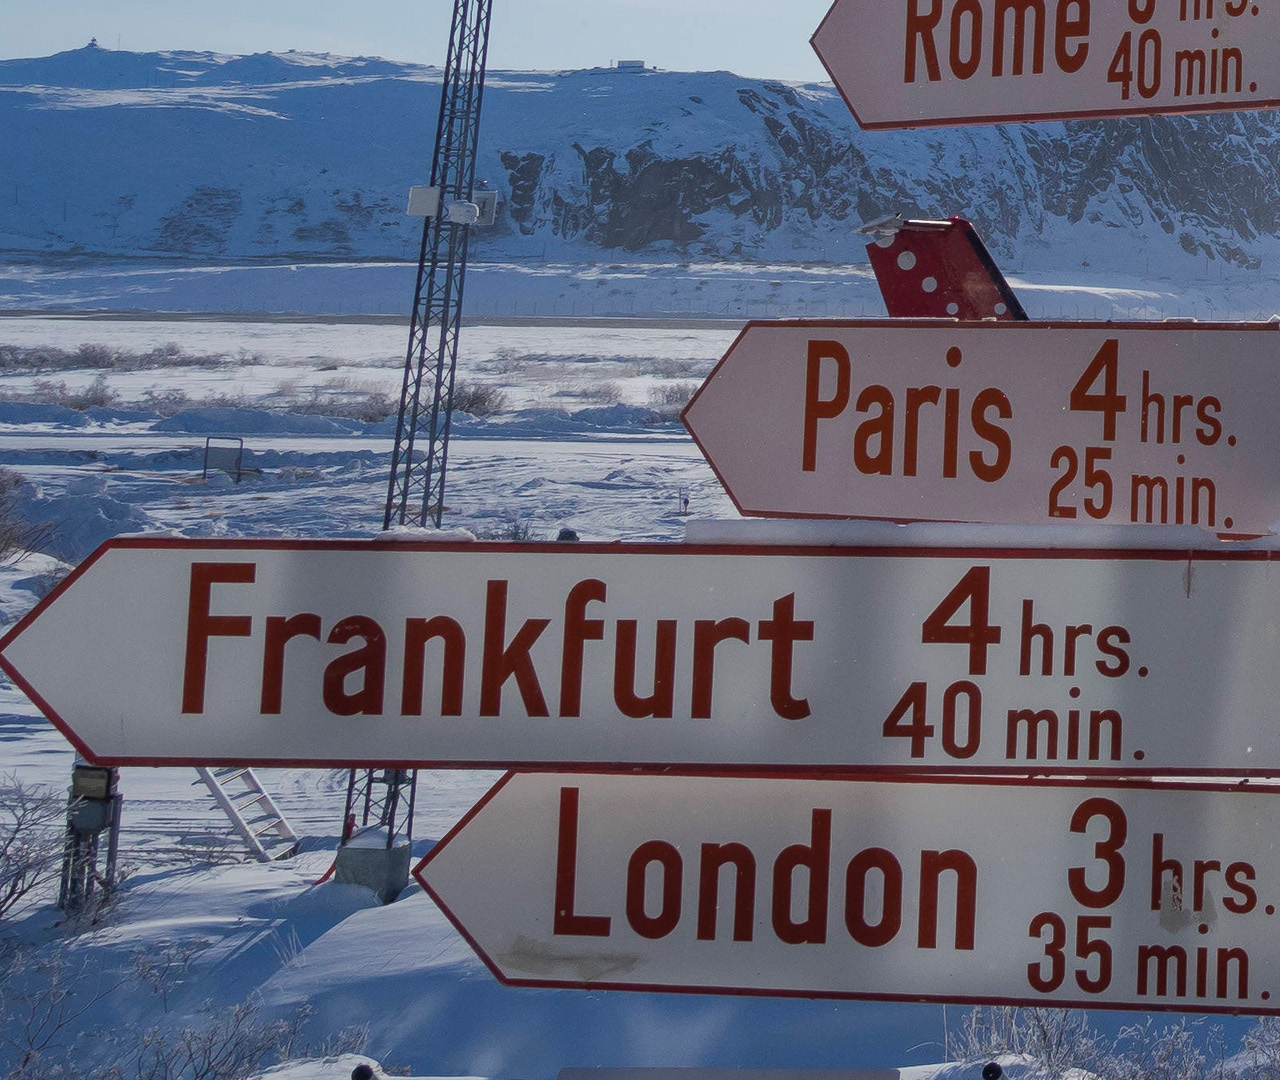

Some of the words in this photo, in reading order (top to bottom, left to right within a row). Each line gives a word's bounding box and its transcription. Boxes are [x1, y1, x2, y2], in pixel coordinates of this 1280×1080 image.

[1107, 29, 1161, 100] 40
[1175, 27, 1258, 97] min.
[802, 339, 1013, 483] Paris
[1070, 339, 1126, 441] 4
[1141, 371, 1238, 447] hrs.
[1048, 445, 1113, 520] 25
[1131, 454, 1235, 529] min.
[181, 562, 815, 719] Frankfurt
[923, 566, 1001, 674] 4
[1020, 600, 1149, 678] hrs.
[882, 681, 981, 758] 40
[1007, 686, 1147, 762] min.
[554, 787, 977, 949] London
[1069, 798, 1126, 908] 3
[1151, 832, 1277, 915] hrs.
[1028, 912, 1113, 994] 35
[1138, 922, 1271, 1001] min.
